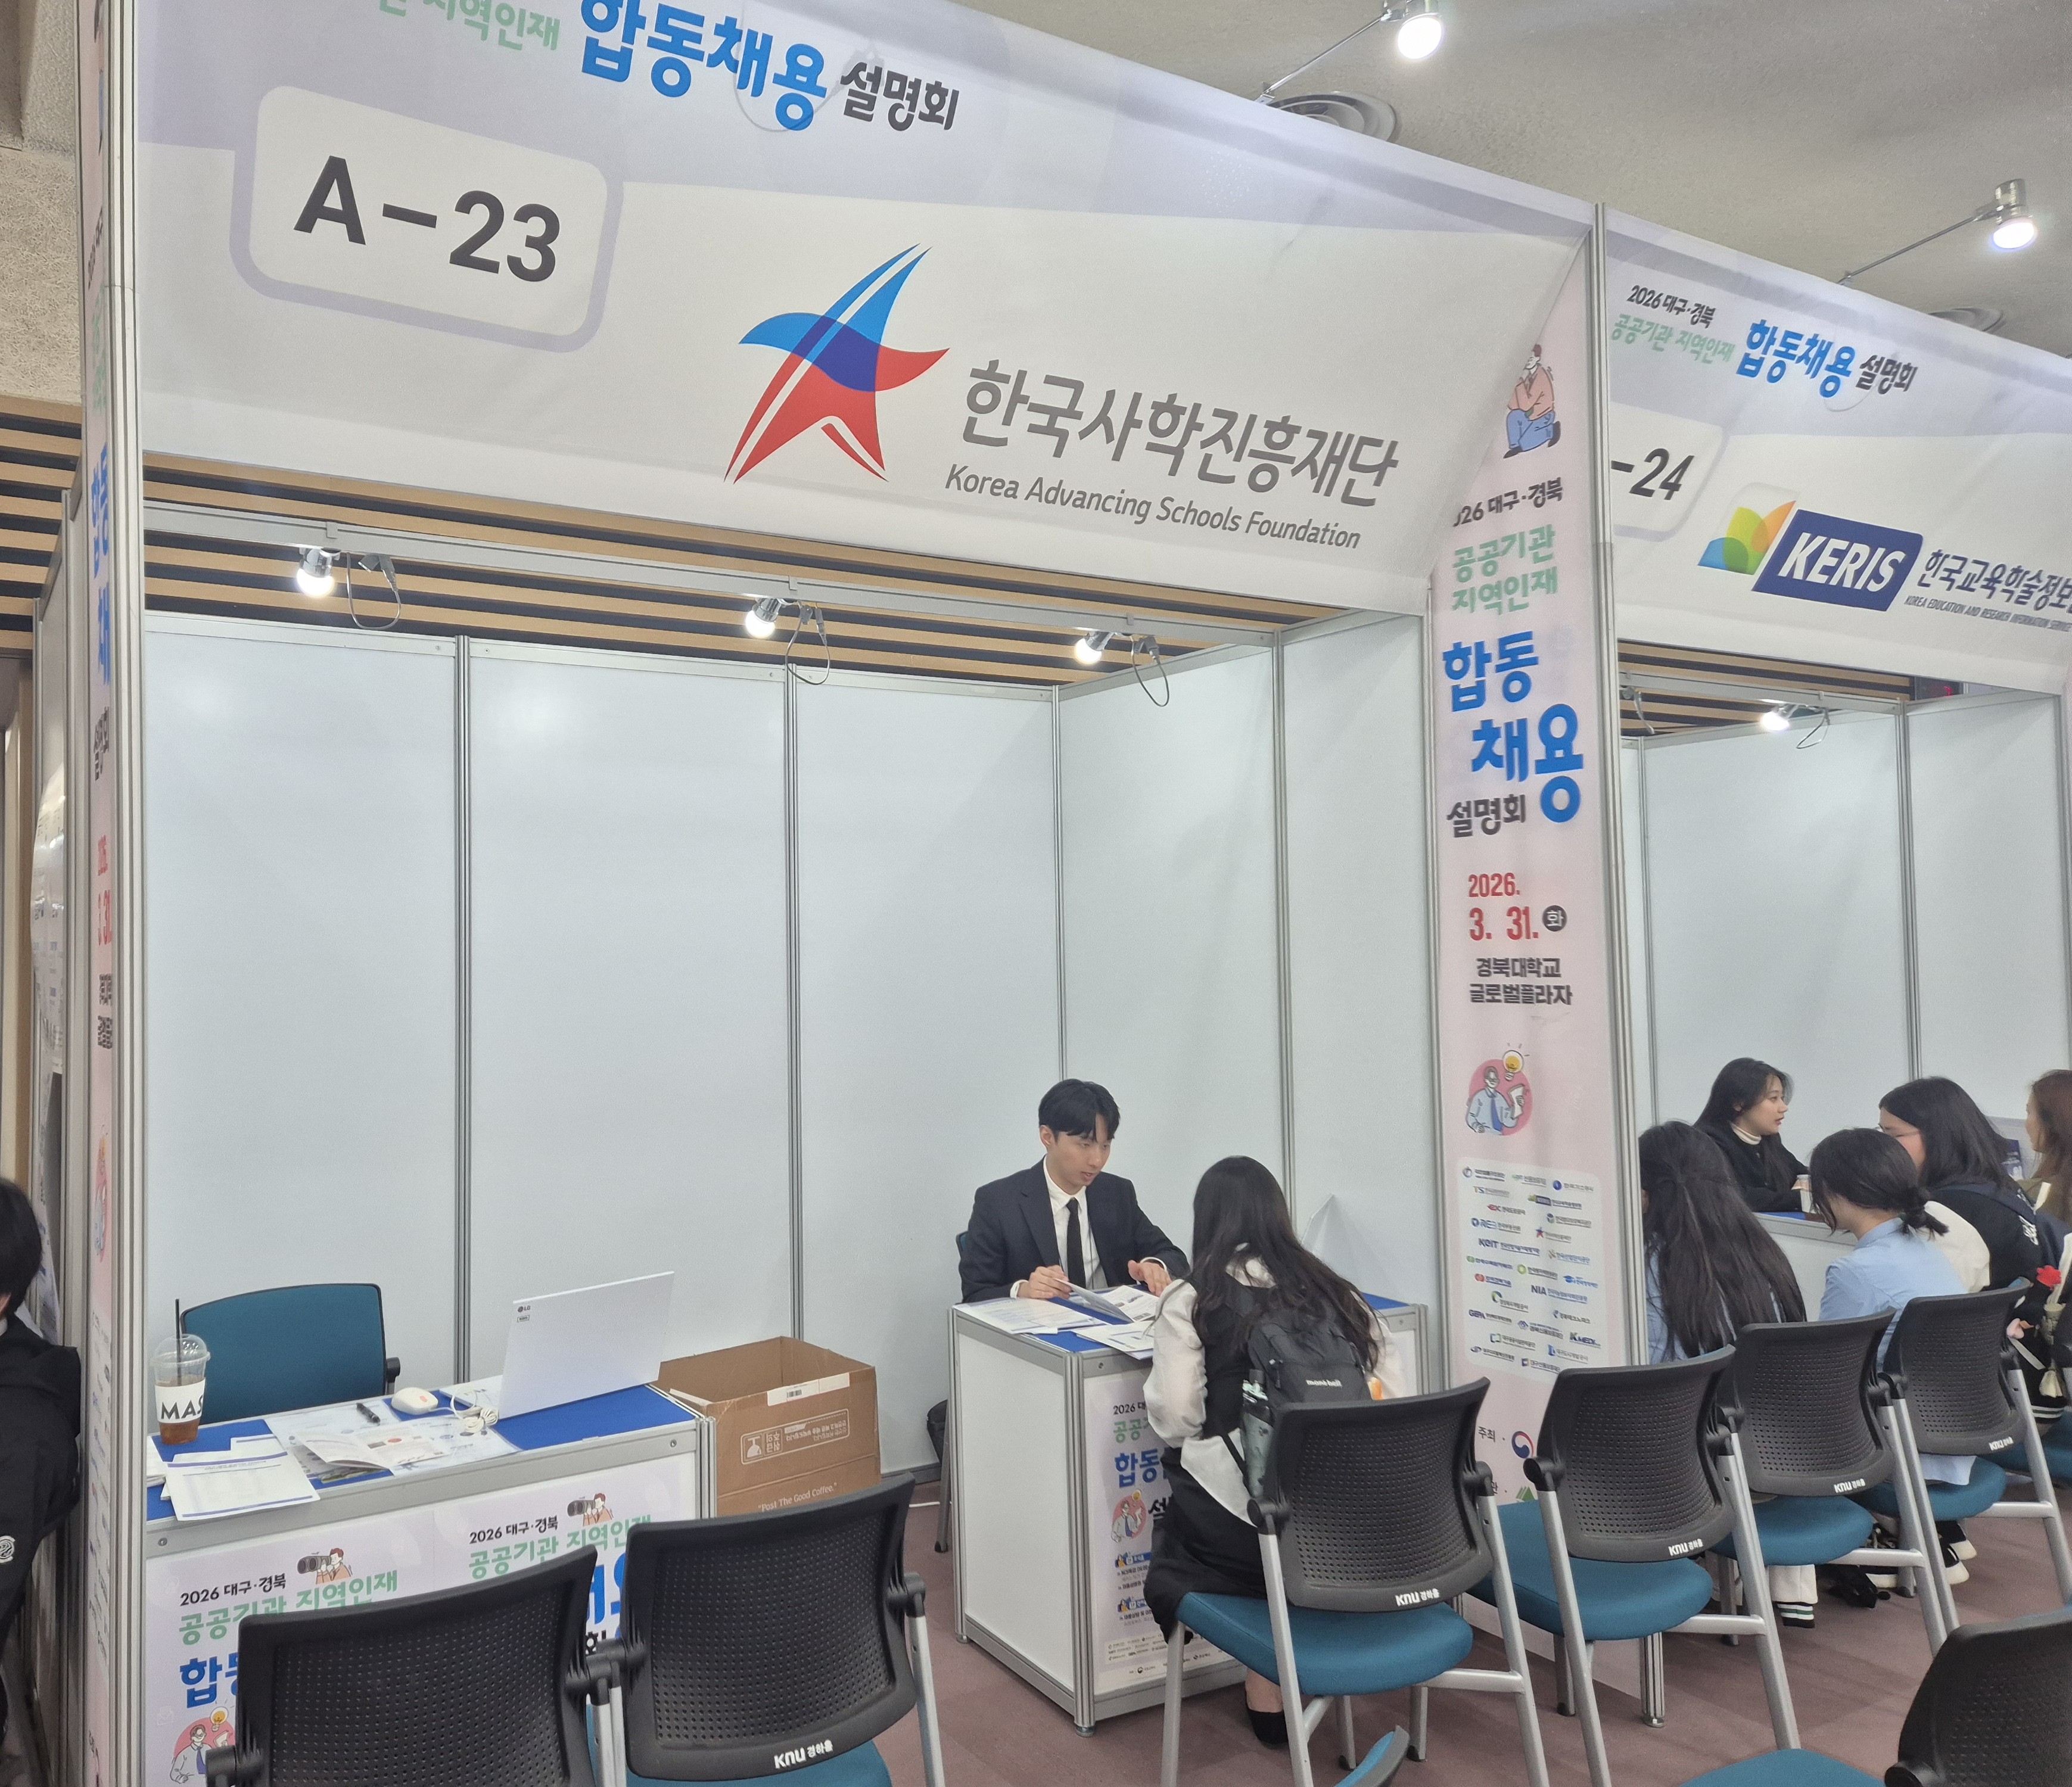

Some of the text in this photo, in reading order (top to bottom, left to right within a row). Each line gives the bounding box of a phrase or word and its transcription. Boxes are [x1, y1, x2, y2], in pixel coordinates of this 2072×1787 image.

[581, 0, 960, 132] 합동채용 설명회
[294, 155, 560, 282] A-23
[1626, 285, 1716, 329] 2026 대구·경북
[1611, 313, 1736, 365] 공공기관 지역인재
[1737, 319, 1918, 399] 합동채용 설명회
[963, 359, 1399, 508] 한국사학진흥재단
[945, 463, 1361, 549] Korea Advancing Schools Foundation
[1487, 477, 1564, 513] 대구·경북
[1452, 524, 1556, 583] 공공기관
[1779, 532, 1906, 593] KERIS
[1452, 566, 1558, 615] 지역인재
[1917, 549, 2072, 614] 한국교육학술정보
[1442, 630, 1539, 712] 합동
[1471, 703, 1584, 823] 채용
[1446, 793, 1526, 838] 설명회
[1468, 872, 1521, 898] 2026.
[1469, 905, 1566, 941] 3. 31. 화
[1476, 957, 1562, 978] 경북대학교
[1469, 983, 1573, 1005] 글로벌플라자
[1531, 1284, 1547, 1296] NIA
[1112, 1402, 1136, 1415] 2026
[1478, 1425, 1496, 1443] 주최
[794, 1490, 811, 1503] Good
[469, 1515, 559, 1545] 2026 대구·경북
[469, 1536, 559, 1580] 공공기관
[179, 1573, 287, 1607] 2026 대구·경북
[295, 1570, 398, 1609] 지역인재
